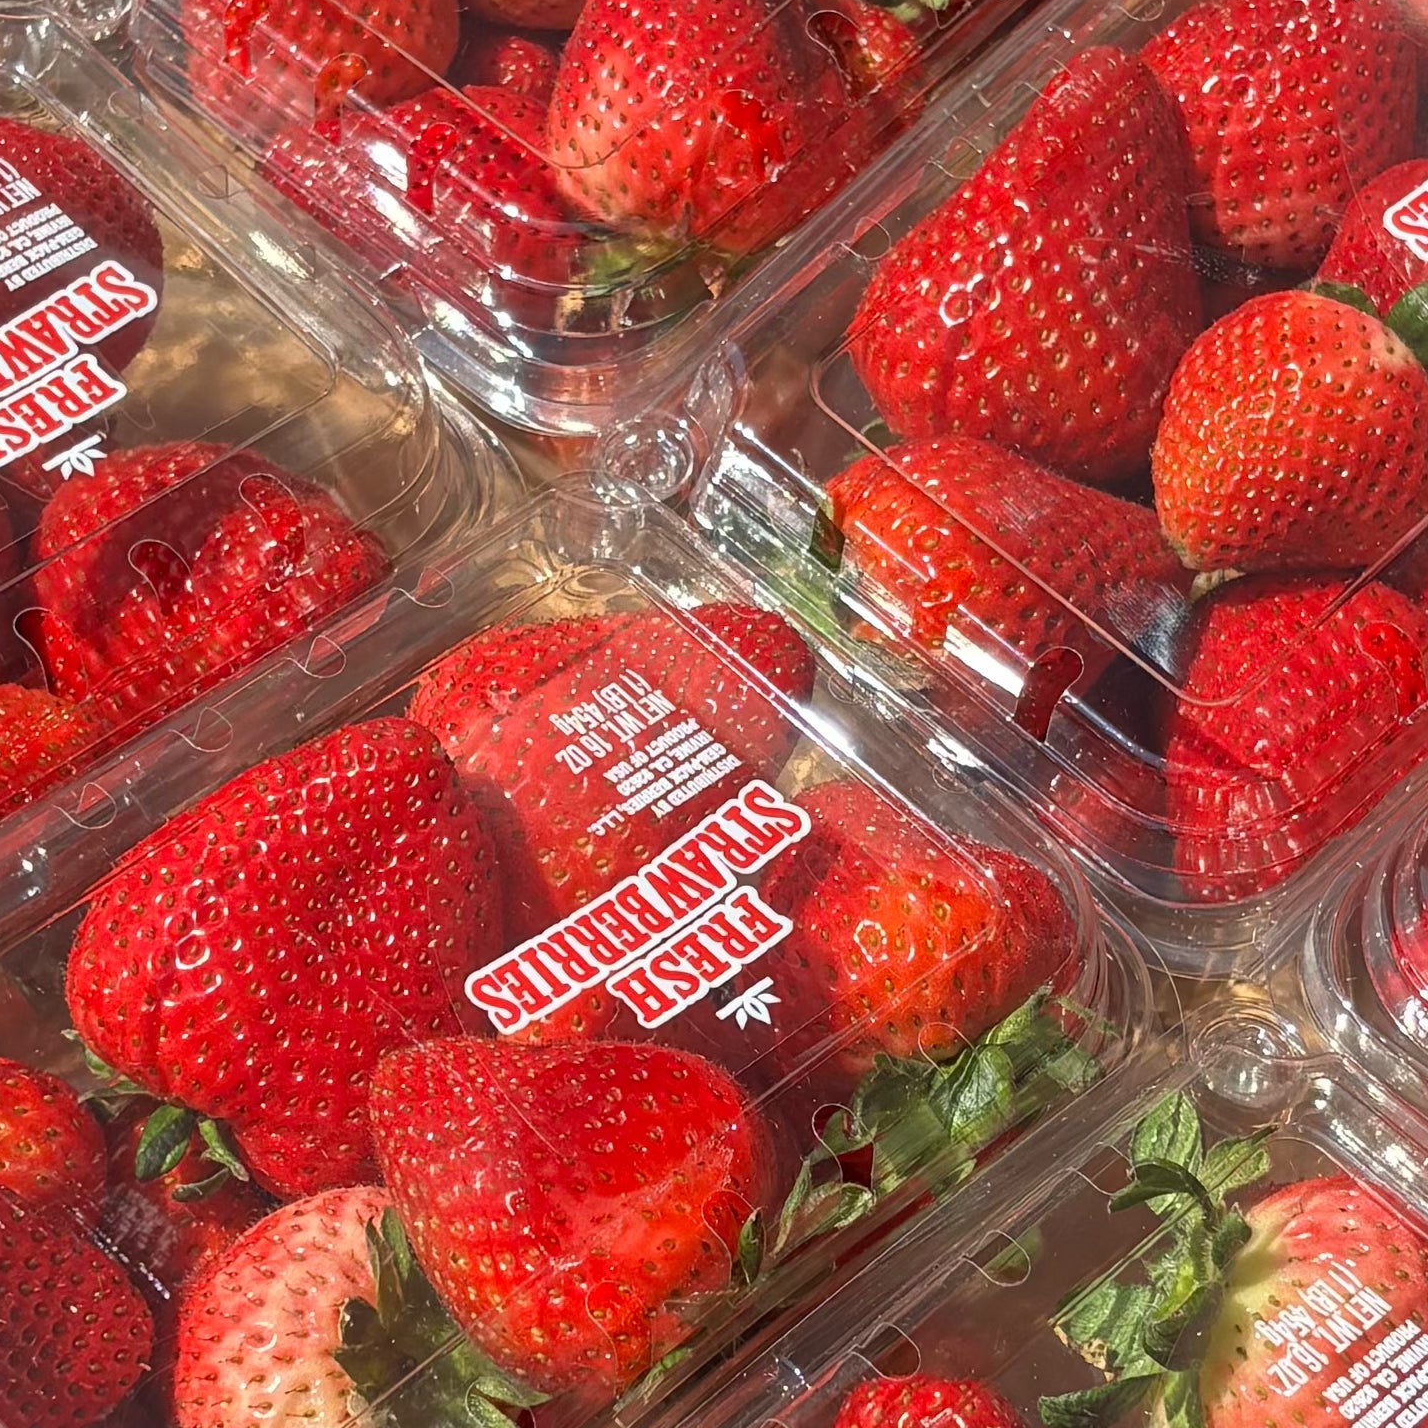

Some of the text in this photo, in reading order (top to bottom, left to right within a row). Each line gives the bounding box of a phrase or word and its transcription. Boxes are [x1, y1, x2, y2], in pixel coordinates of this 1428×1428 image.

[546, 693, 608, 741] 454g
[552, 688, 677, 776] NET WT. 16 OZ
[590, 677, 635, 715] LB)
[467, 782, 803, 1028] STRAWBERRIES
[611, 891, 785, 1027] FRESH
[1254, 1294, 1320, 1354] 454g
[1296, 1273, 1347, 1319] LB)
[1265, 1284, 1394, 1397] NET WT. 16 OZ
[1320, 1317, 1421, 1406] PRODUCT OF USA
